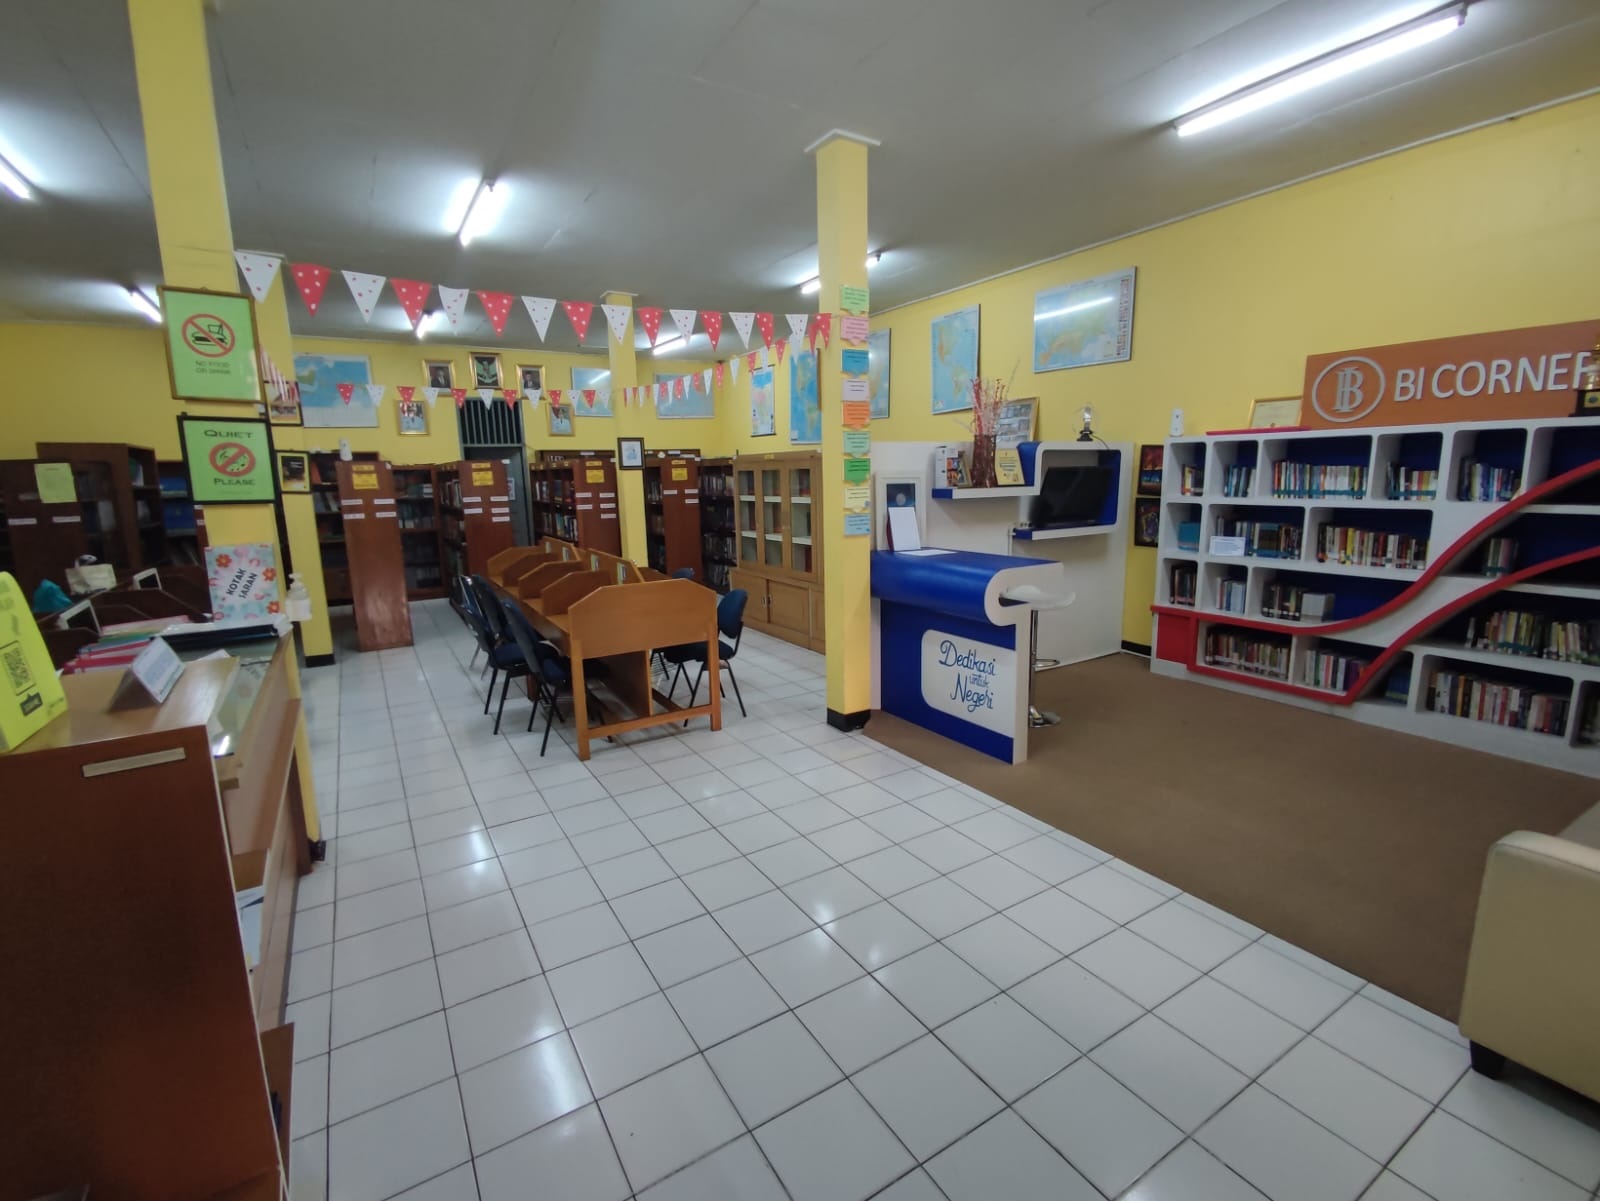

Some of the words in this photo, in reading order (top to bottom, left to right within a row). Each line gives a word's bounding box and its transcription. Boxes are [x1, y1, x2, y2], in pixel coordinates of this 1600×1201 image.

[1394, 366, 1425, 402] BI
[203, 429, 254, 439] QUIET
[213, 477, 256, 486] PLEASE
[225, 567, 247, 596] KOTAK
[238, 572, 258, 599] SARAN
[938, 639, 996, 676] Dedikasi
[949, 672, 994, 713] Negeri
